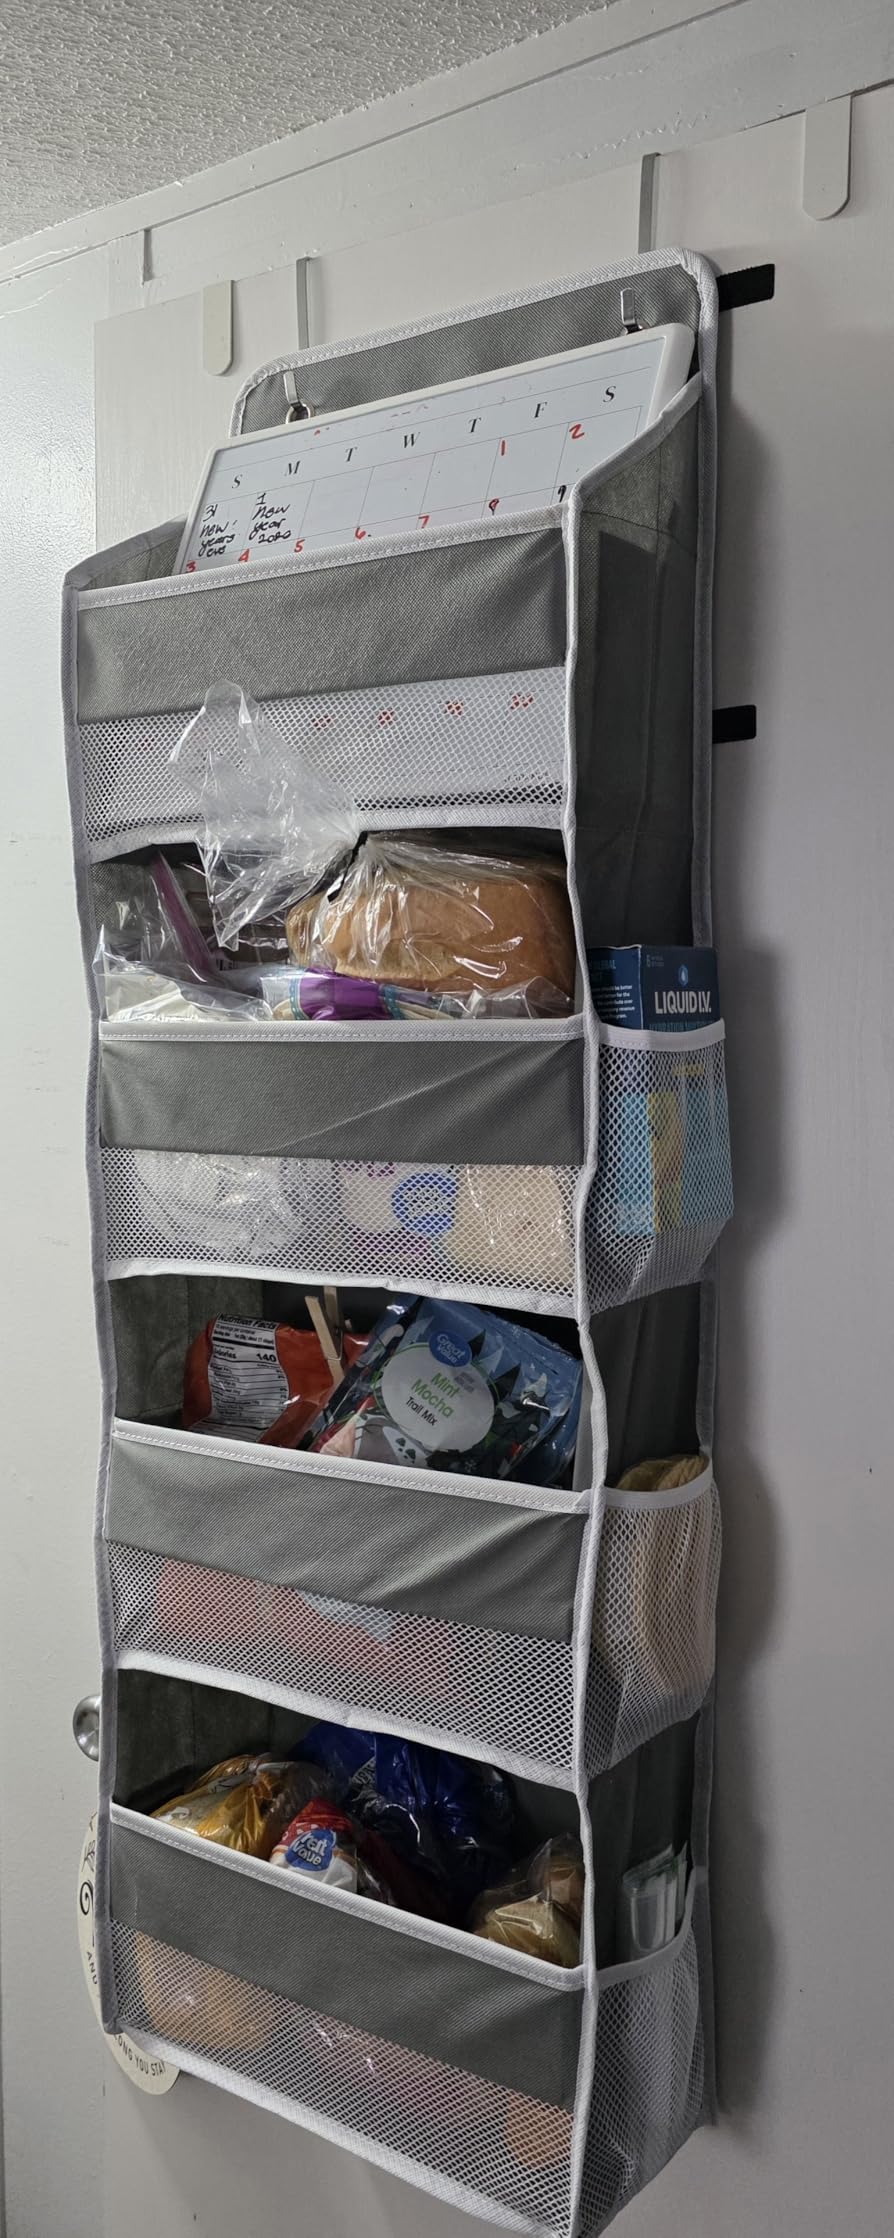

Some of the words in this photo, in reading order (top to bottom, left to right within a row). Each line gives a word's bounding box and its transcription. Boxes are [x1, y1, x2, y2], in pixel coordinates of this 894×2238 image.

[231, 474, 243, 489] S
[284, 460, 300, 476] M
[344, 446, 358, 462] T
[403, 432, 420, 449] W
[468, 417, 482, 433] T
[533, 401, 548, 418] F
[602, 385, 617, 403] S
[569, 424, 585, 439] 2
[418, 515, 429, 528] 7
[238, 548, 250, 562] 4
[294, 539, 305, 553] 5
[186, 561, 196, 573] 3
[654, 991, 698, 1014] LIQUID
[253, 1320, 276, 1330] Facts
[437, 1334, 466, 1359] Great
[437, 1344, 459, 1363] Value
[256, 1353, 277, 1362] 140
[431, 1372, 460, 1398] Mint
[411, 1378, 455, 1418] Mocha
[406, 1396, 424, 1415] Trail
[421, 1410, 438, 1426] Mix
[134, 2054, 149, 2075] YOU
